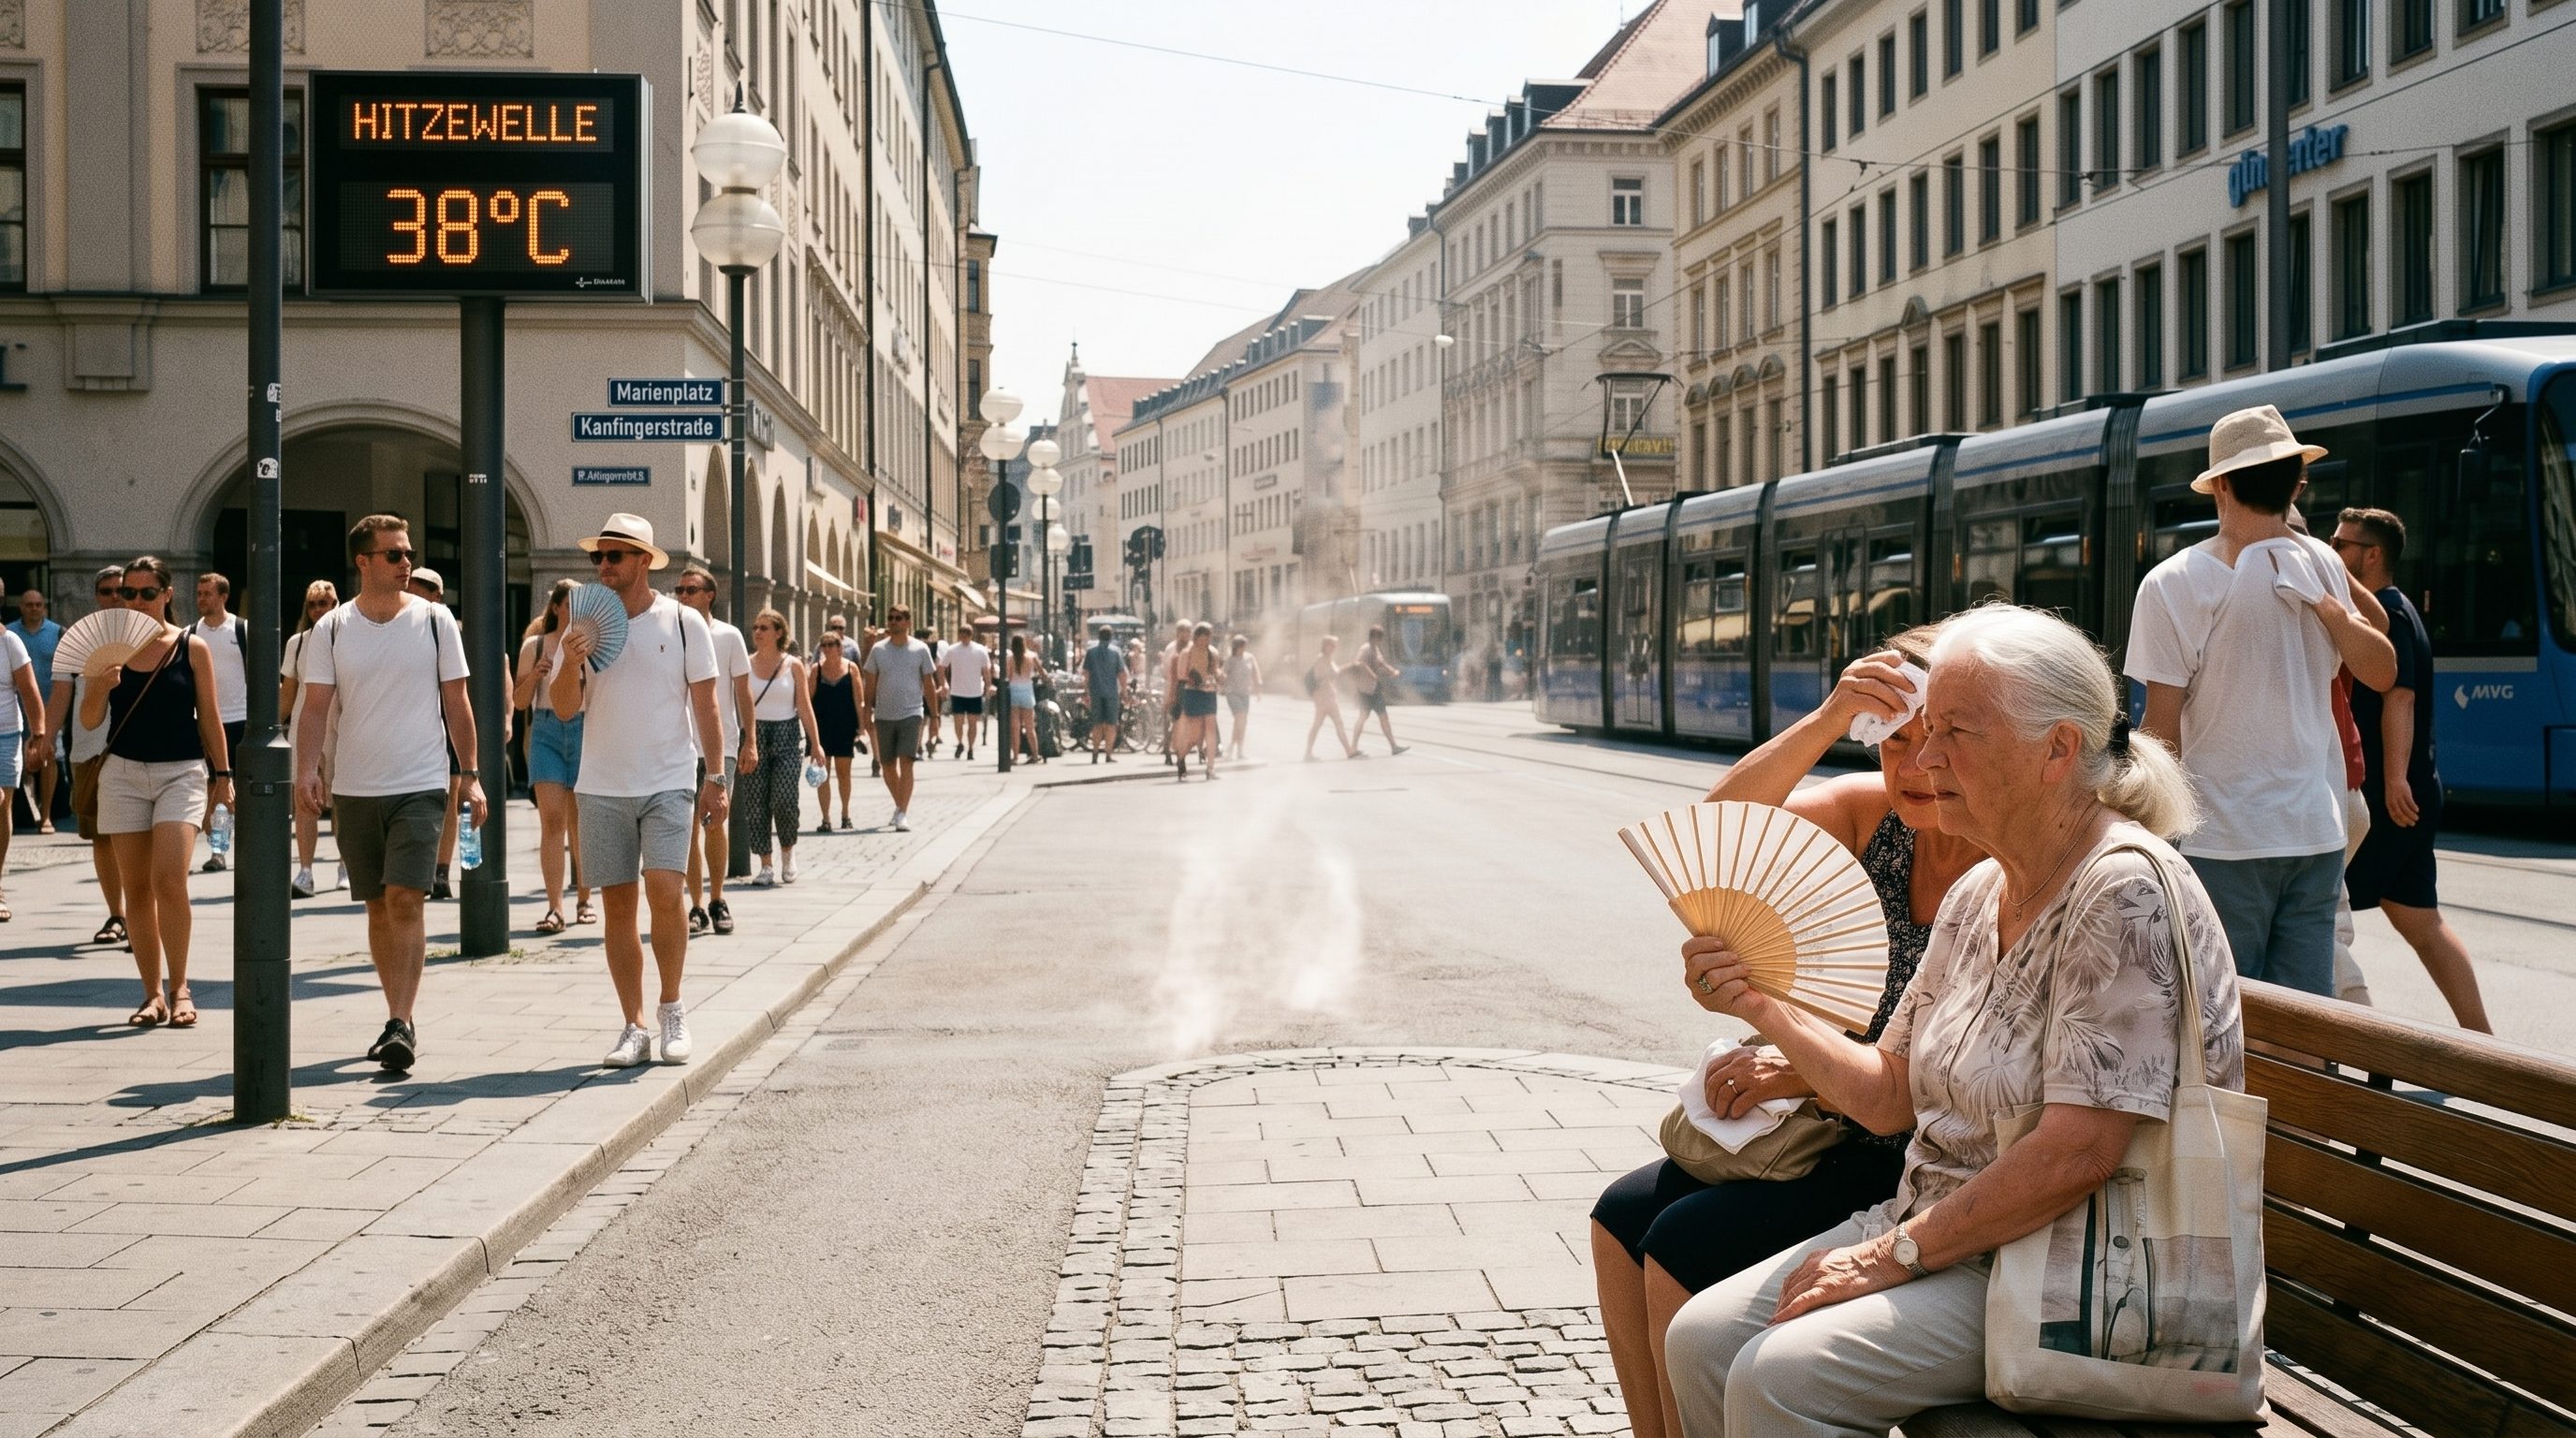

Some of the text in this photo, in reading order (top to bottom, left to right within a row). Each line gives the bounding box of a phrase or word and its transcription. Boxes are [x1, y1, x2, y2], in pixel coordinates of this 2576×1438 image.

[354, 102, 597, 140] HITZEWELLE
[387, 189, 569, 264] 38°C
[617, 382, 713, 405] Marienplatz
[2470, 684, 2514, 699] MVG
